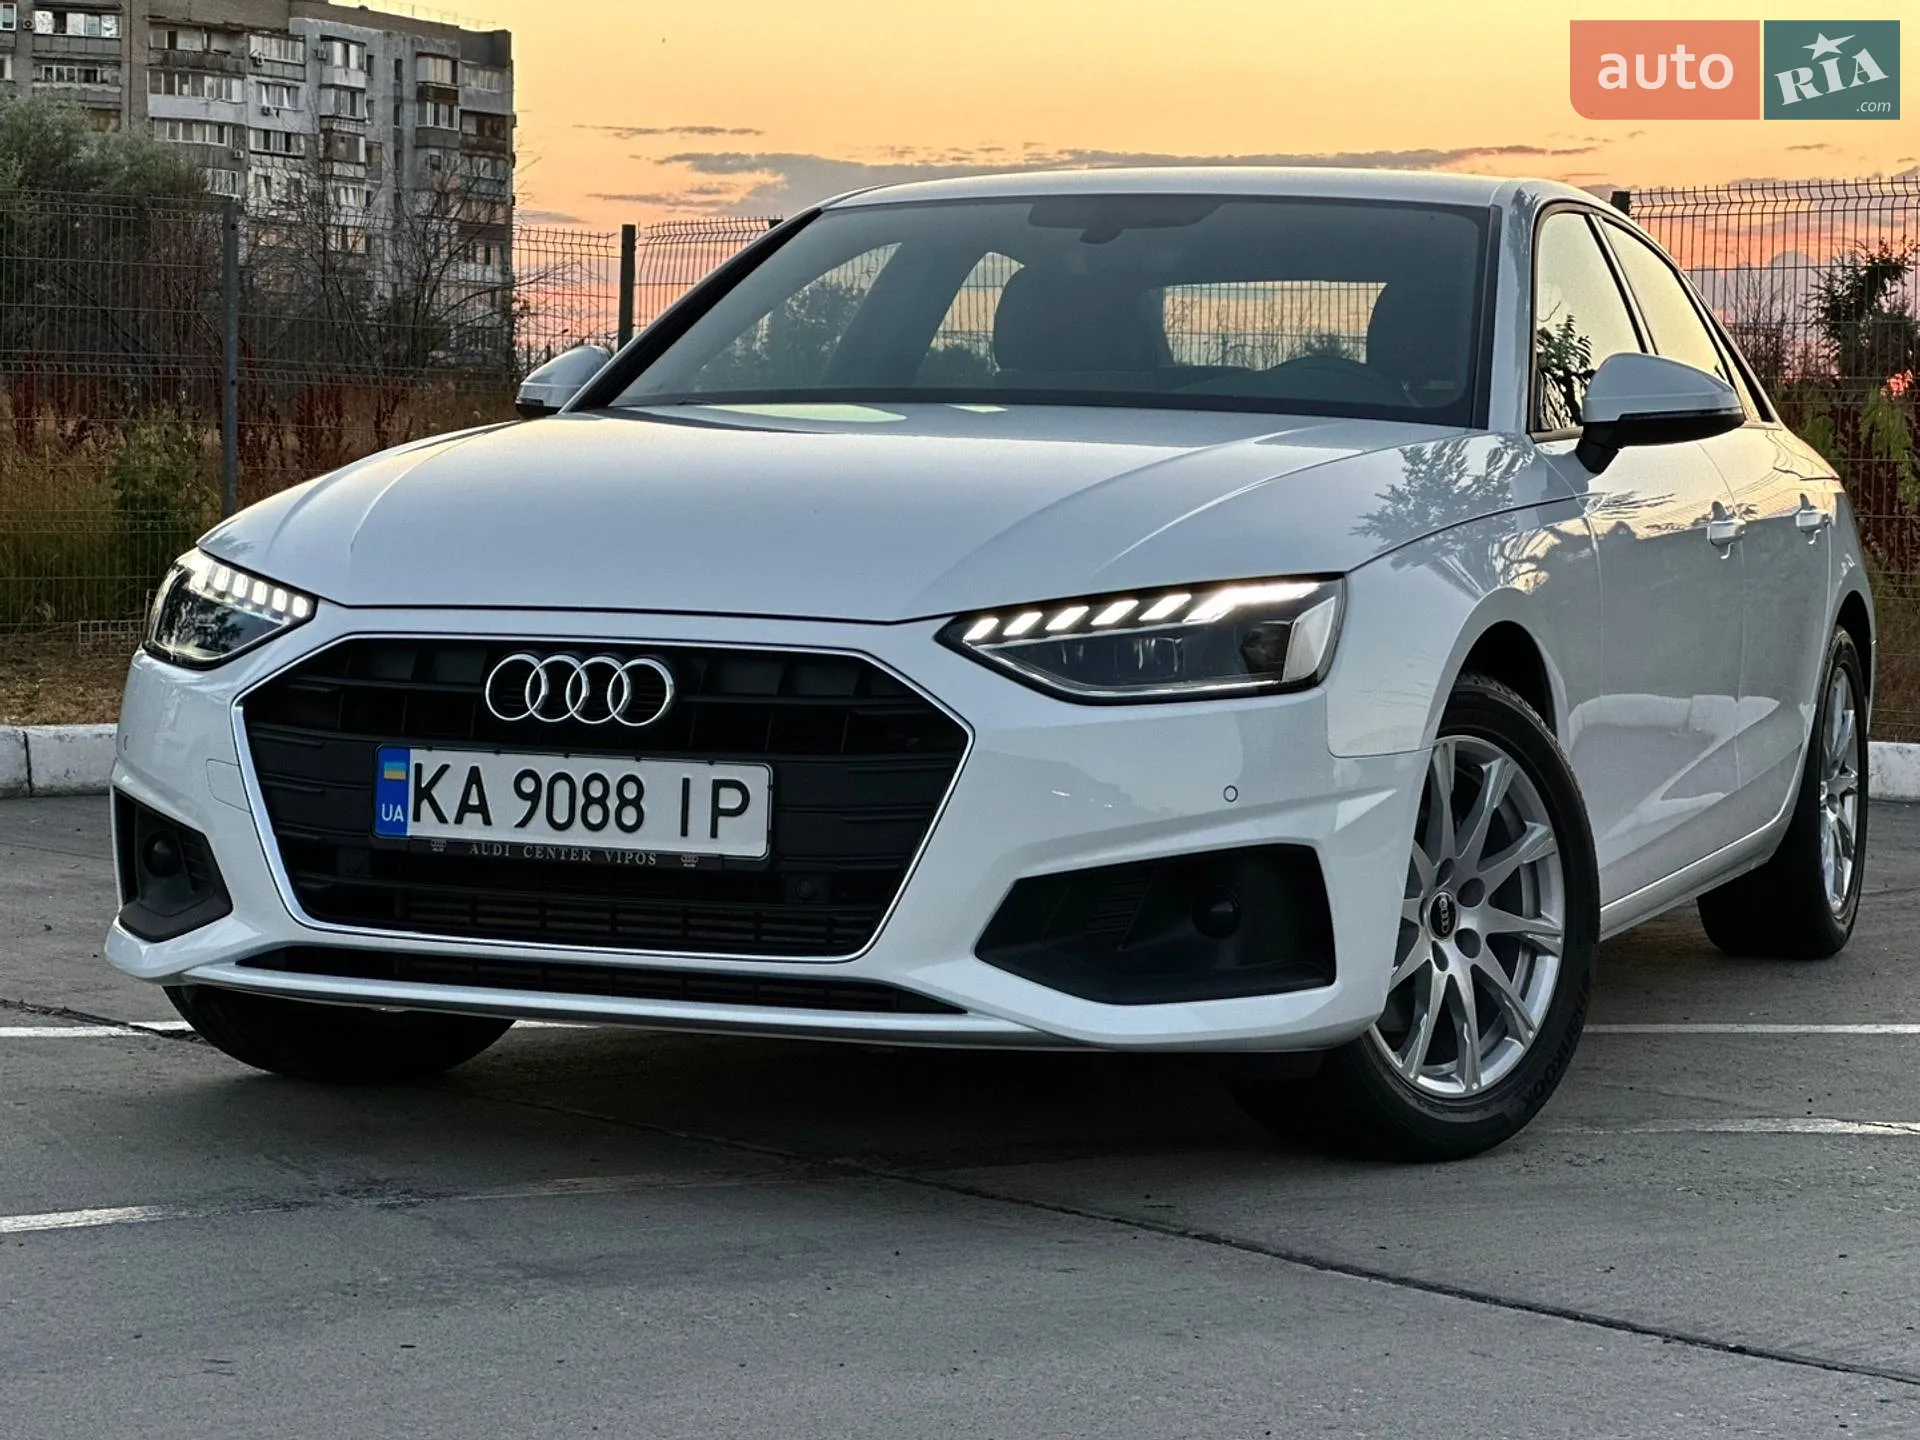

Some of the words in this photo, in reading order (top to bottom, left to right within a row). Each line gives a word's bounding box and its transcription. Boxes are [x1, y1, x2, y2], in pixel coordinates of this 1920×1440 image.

[412, 762, 493, 827] KA
[513, 768, 645, 834] 9088
[680, 776, 751, 839] IP
[381, 803, 404, 823] UA
[470, 842, 512, 857] AUDI
[523, 845, 592, 862] CENTER
[605, 850, 657, 866] VIPOS
